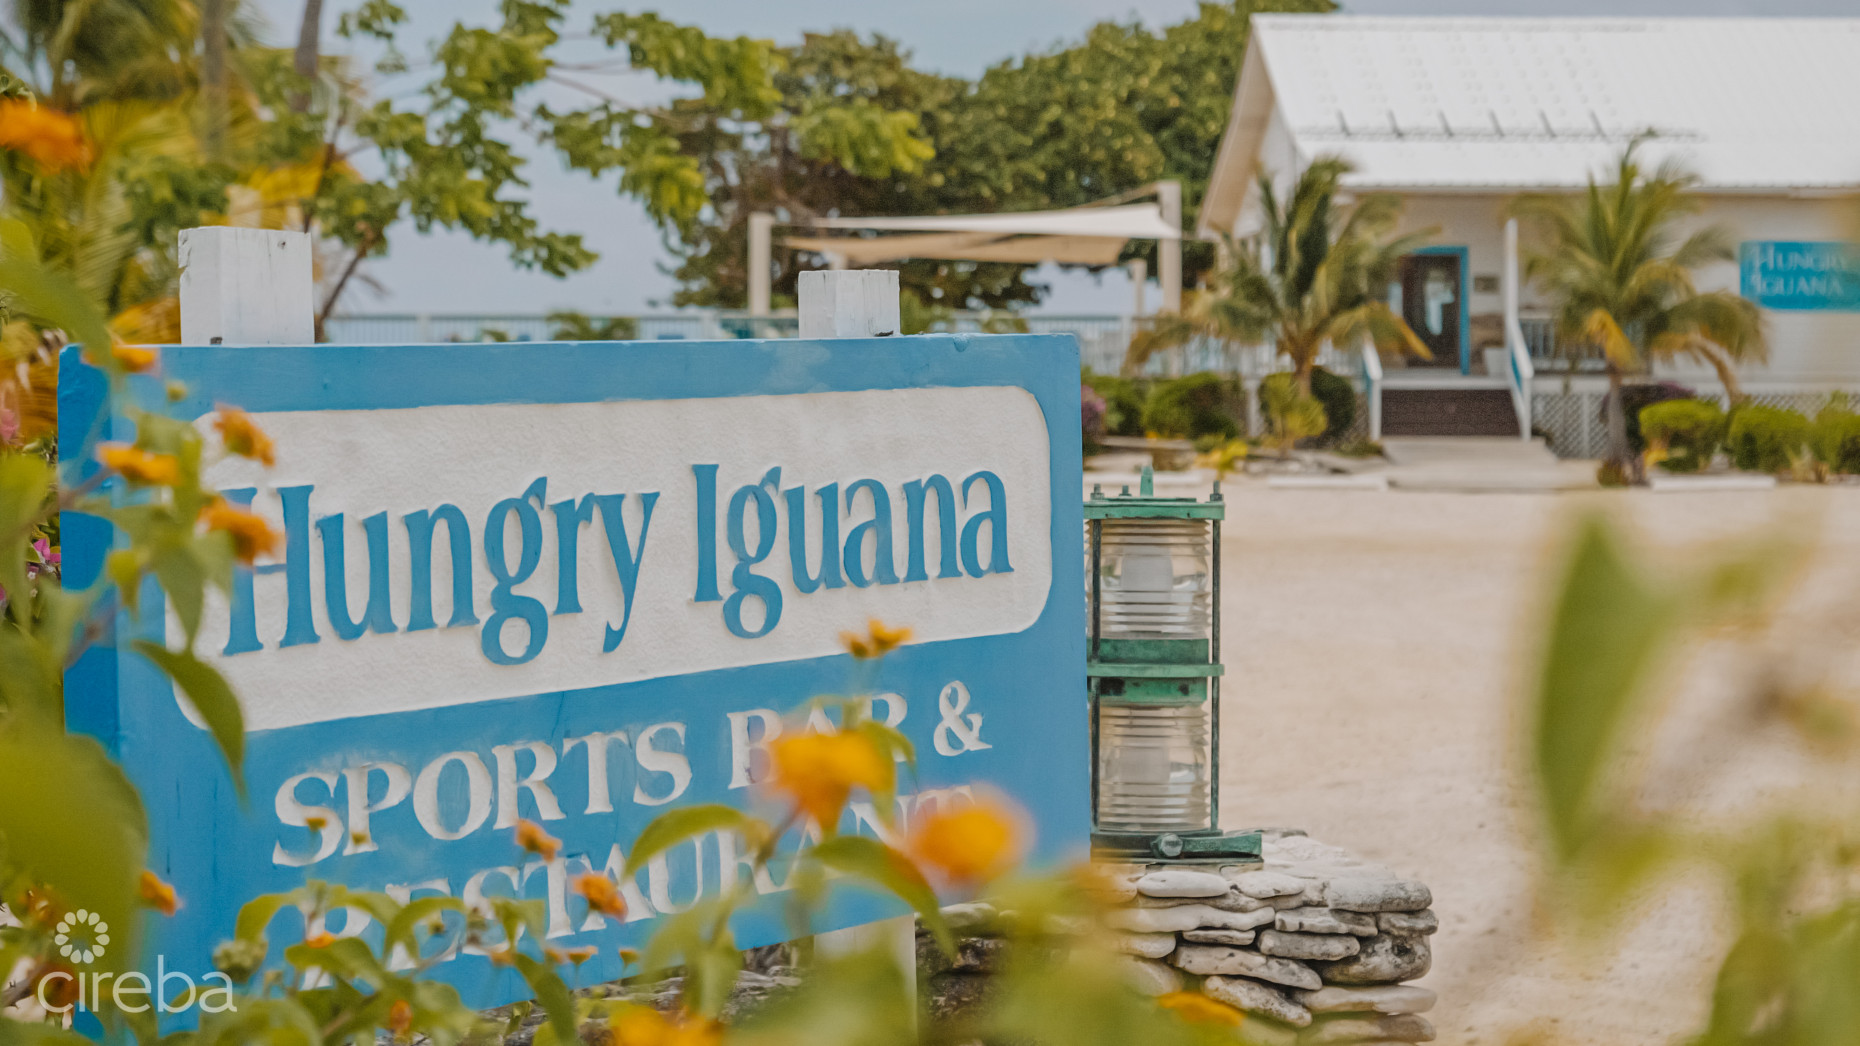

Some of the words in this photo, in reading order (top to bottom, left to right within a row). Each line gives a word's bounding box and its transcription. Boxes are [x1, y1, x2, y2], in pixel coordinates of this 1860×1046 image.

[1749, 243, 1853, 271] HUNGR
[1751, 274, 1845, 296] IGUANA
[221, 475, 661, 666] Hungry
[691, 463, 1015, 640] Iguana
[272, 721, 693, 868] SPORTS
[932, 680, 994, 757] &
